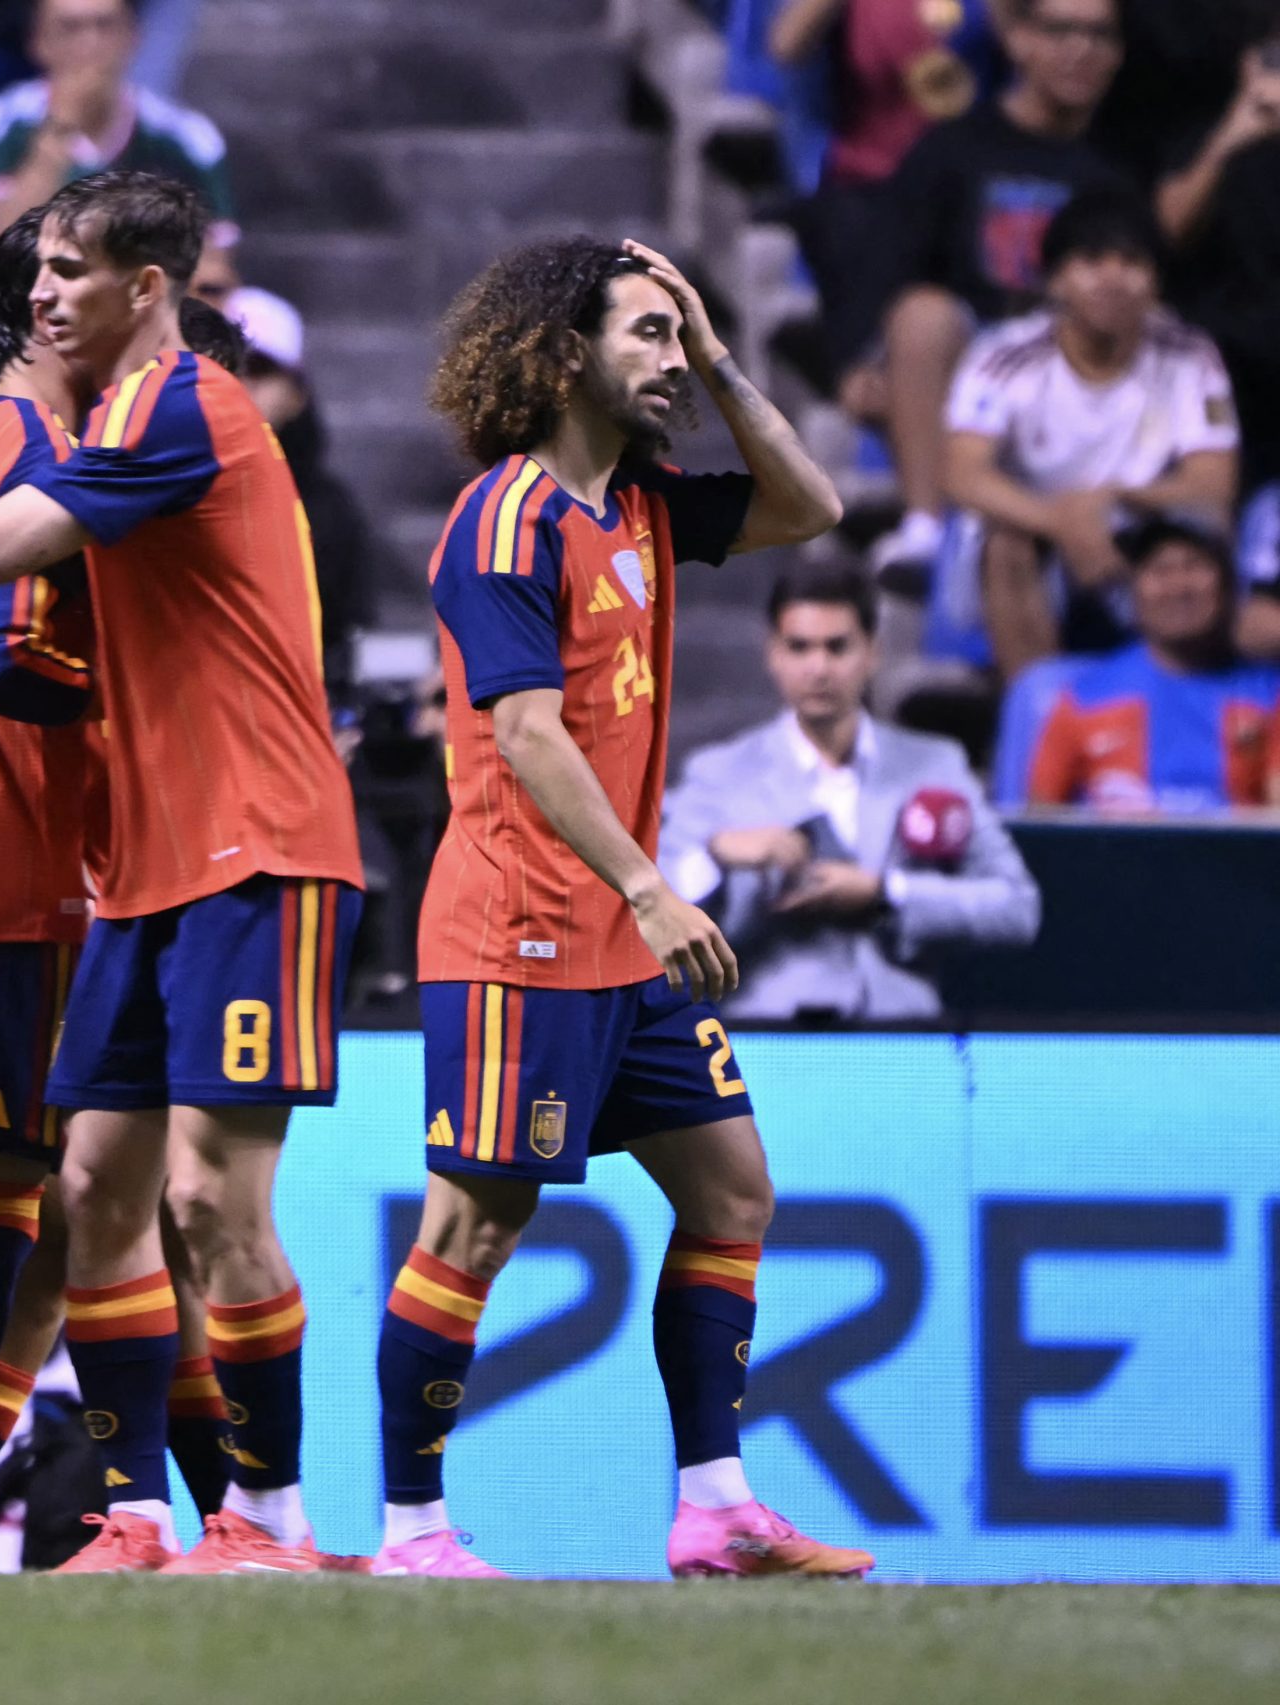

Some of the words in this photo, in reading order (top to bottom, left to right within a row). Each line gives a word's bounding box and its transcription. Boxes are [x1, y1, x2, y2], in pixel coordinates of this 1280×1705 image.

[611, 635, 656, 718] 24
[223, 999, 271, 1083] 8
[380, 1194, 1280, 1532] PRE
